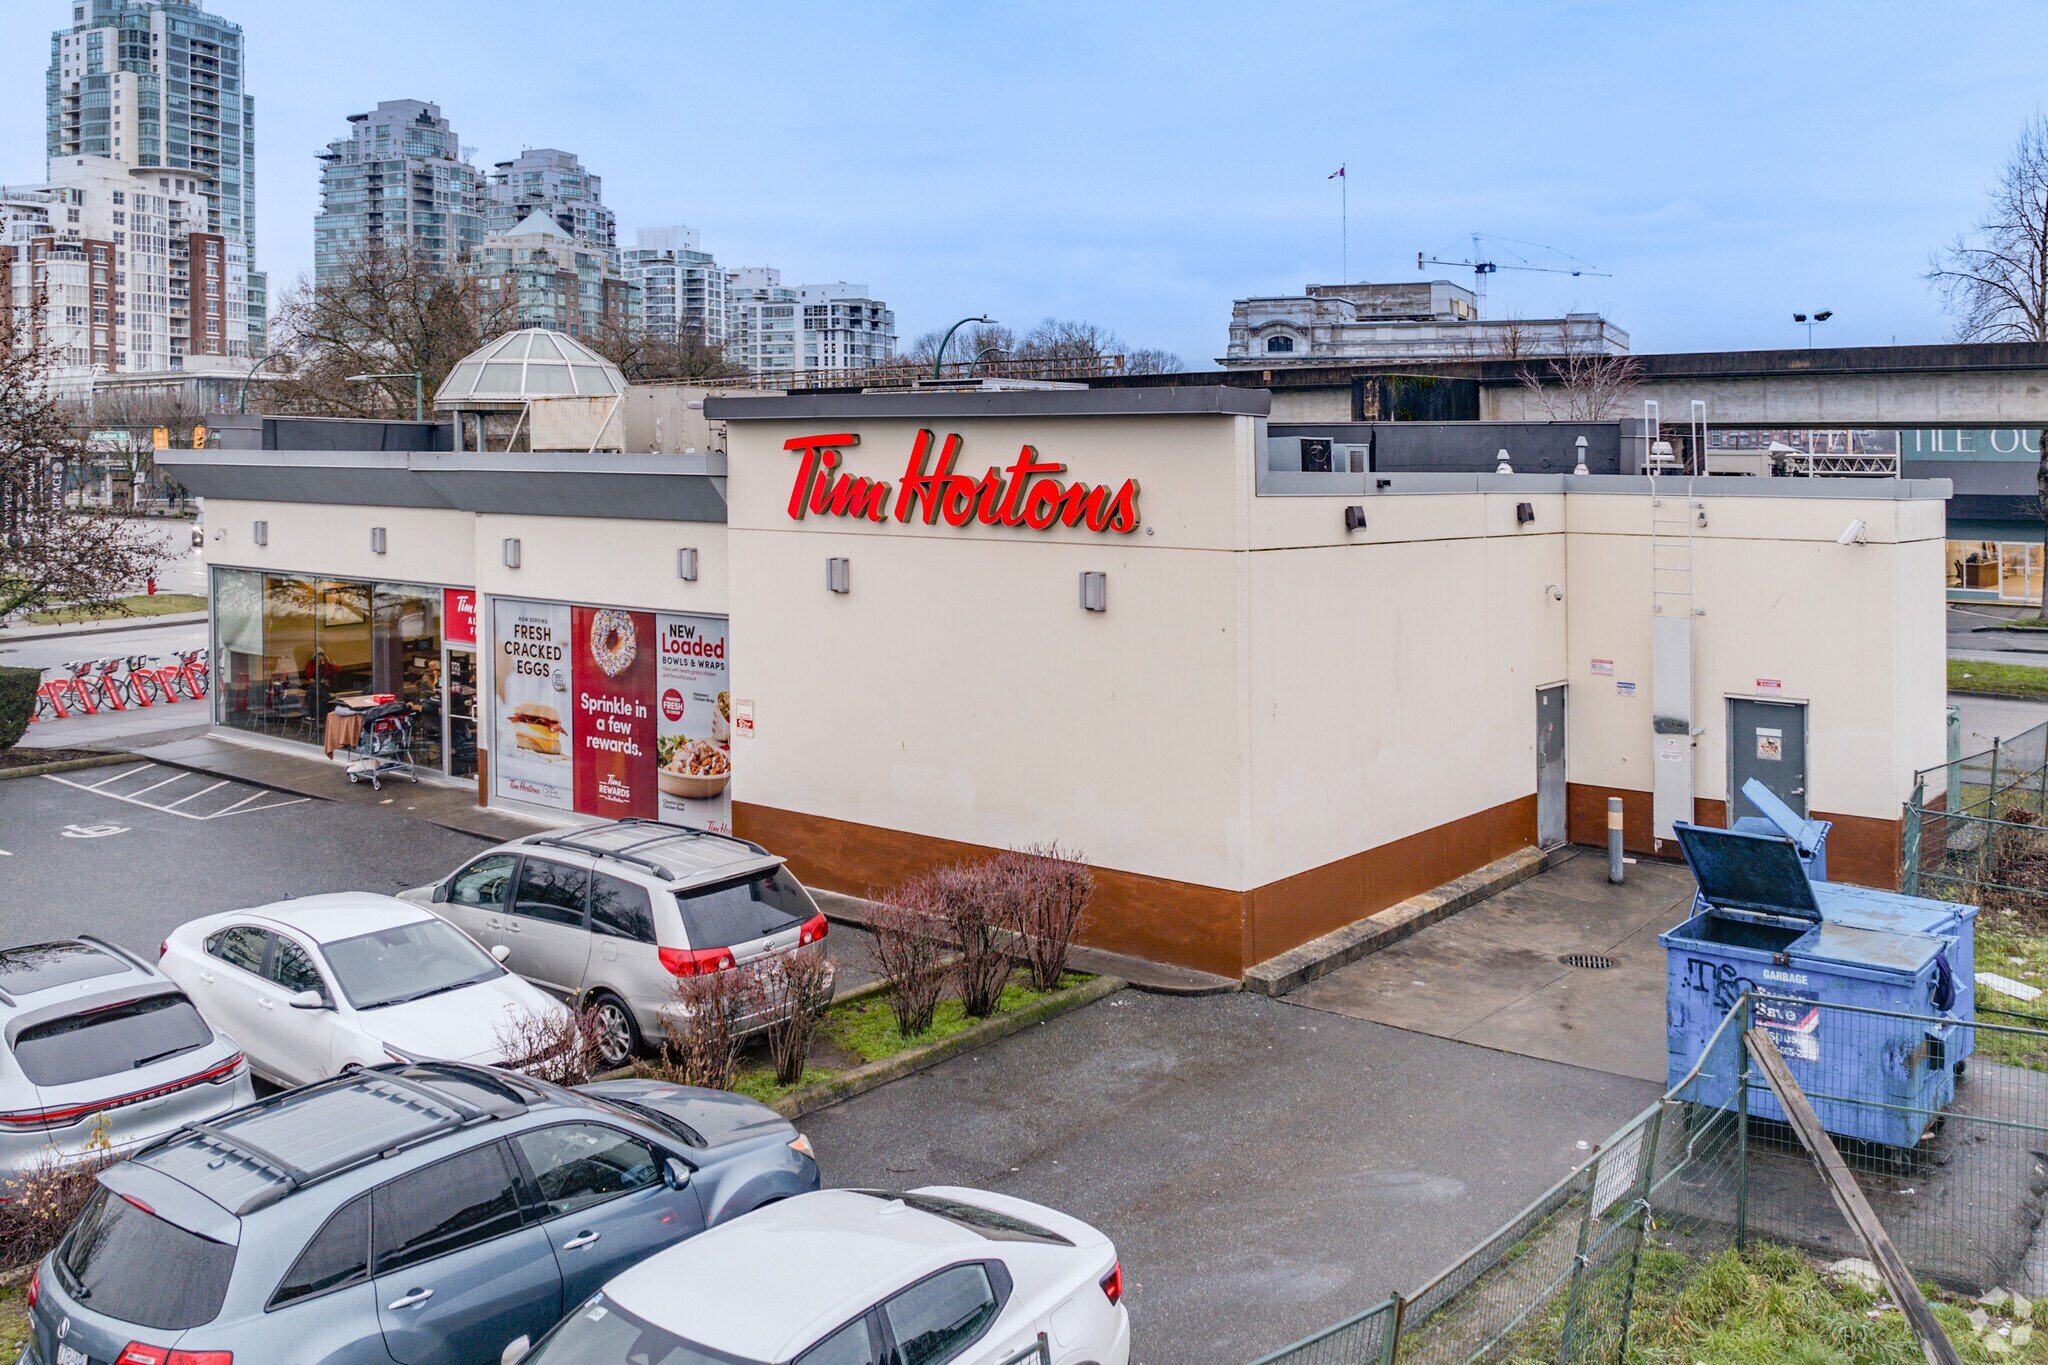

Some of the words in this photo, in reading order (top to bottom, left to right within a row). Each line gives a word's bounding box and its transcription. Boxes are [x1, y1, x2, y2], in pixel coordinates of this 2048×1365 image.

[784, 433, 892, 522] Tim
[895, 428, 1141, 534] Hortons
[457, 595, 473, 614] Tim
[514, 624, 551, 642] FRESH
[669, 624, 695, 639] NEW
[504, 640, 562, 661] CRACKED
[662, 632, 725, 659] Loaded
[517, 660, 550, 677] EGGS
[662, 656, 688, 667] BOWLS
[690, 659, 696, 667] &
[698, 660, 725, 671] WRAPS
[581, 692, 633, 716] Sprinkle
[635, 699, 647, 719] in
[663, 701, 683, 711] FRESH
[596, 718, 605, 731] a
[608, 715, 632, 735] few
[586, 736, 642, 757] rewards.
[509, 780, 519, 790] Tim
[519, 781, 541, 795] Hortons
[607, 774, 622, 787] Tims
[599, 784, 630, 798] REWARDS
[707, 820, 719, 833] Tim
[1763, 968, 1809, 985] GARBAGE
[1755, 1001, 1796, 1021] Save
